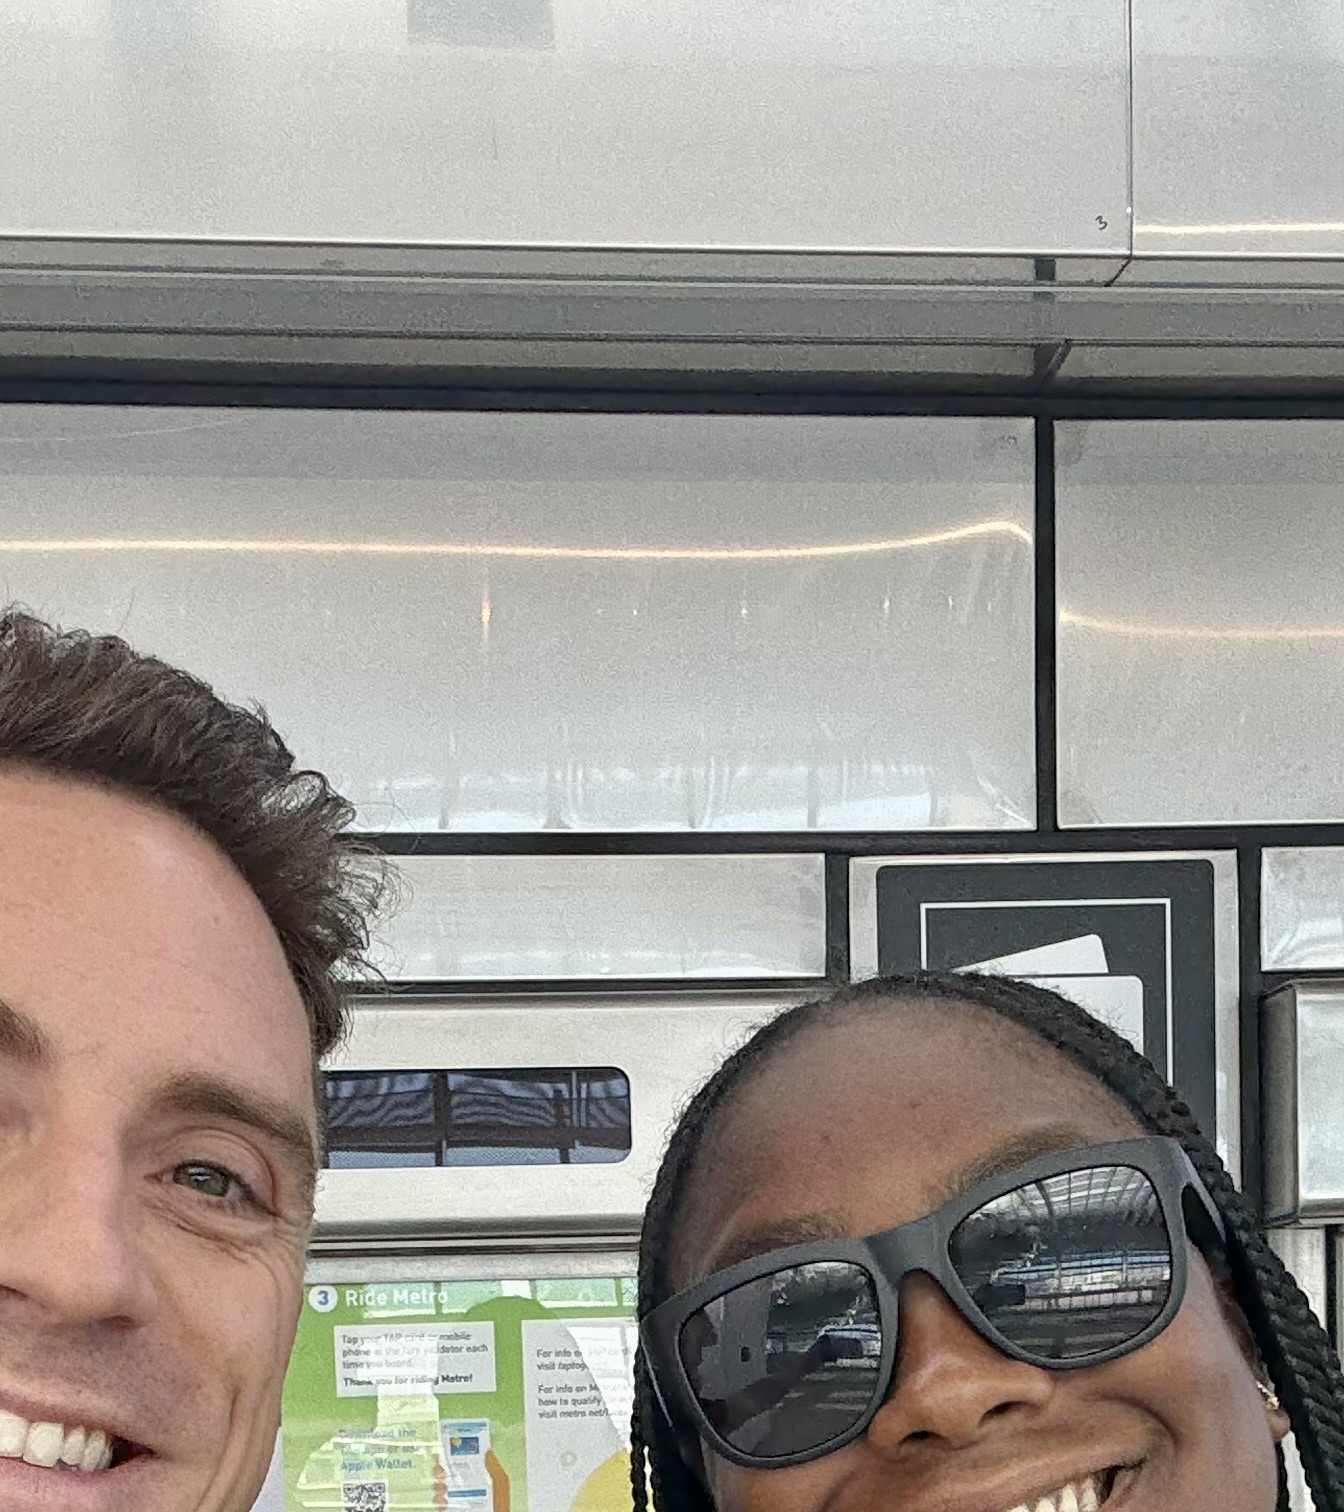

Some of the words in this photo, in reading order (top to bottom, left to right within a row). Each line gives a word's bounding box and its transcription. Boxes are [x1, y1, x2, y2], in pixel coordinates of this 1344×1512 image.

[344, 1289, 388, 1308] Ride
[392, 1288, 448, 1305] Metro
[342, 1334, 358, 1345] Tap
[439, 1331, 472, 1341] mobile
[466, 1344, 489, 1353] each
[536, 1348, 553, 1358] For
[554, 1347, 572, 1358] info
[536, 1362, 556, 1371] visit
[343, 1377, 373, 1387] Thank
[441, 1373, 473, 1384] Metro!
[538, 1384, 554, 1394] For
[555, 1383, 573, 1393] info
[575, 1385, 587, 1393] on
[559, 1396, 569, 1406] to
[538, 1409, 558, 1419] visit
[398, 1428, 417, 1438] the
[340, 1459, 372, 1472] Apple
